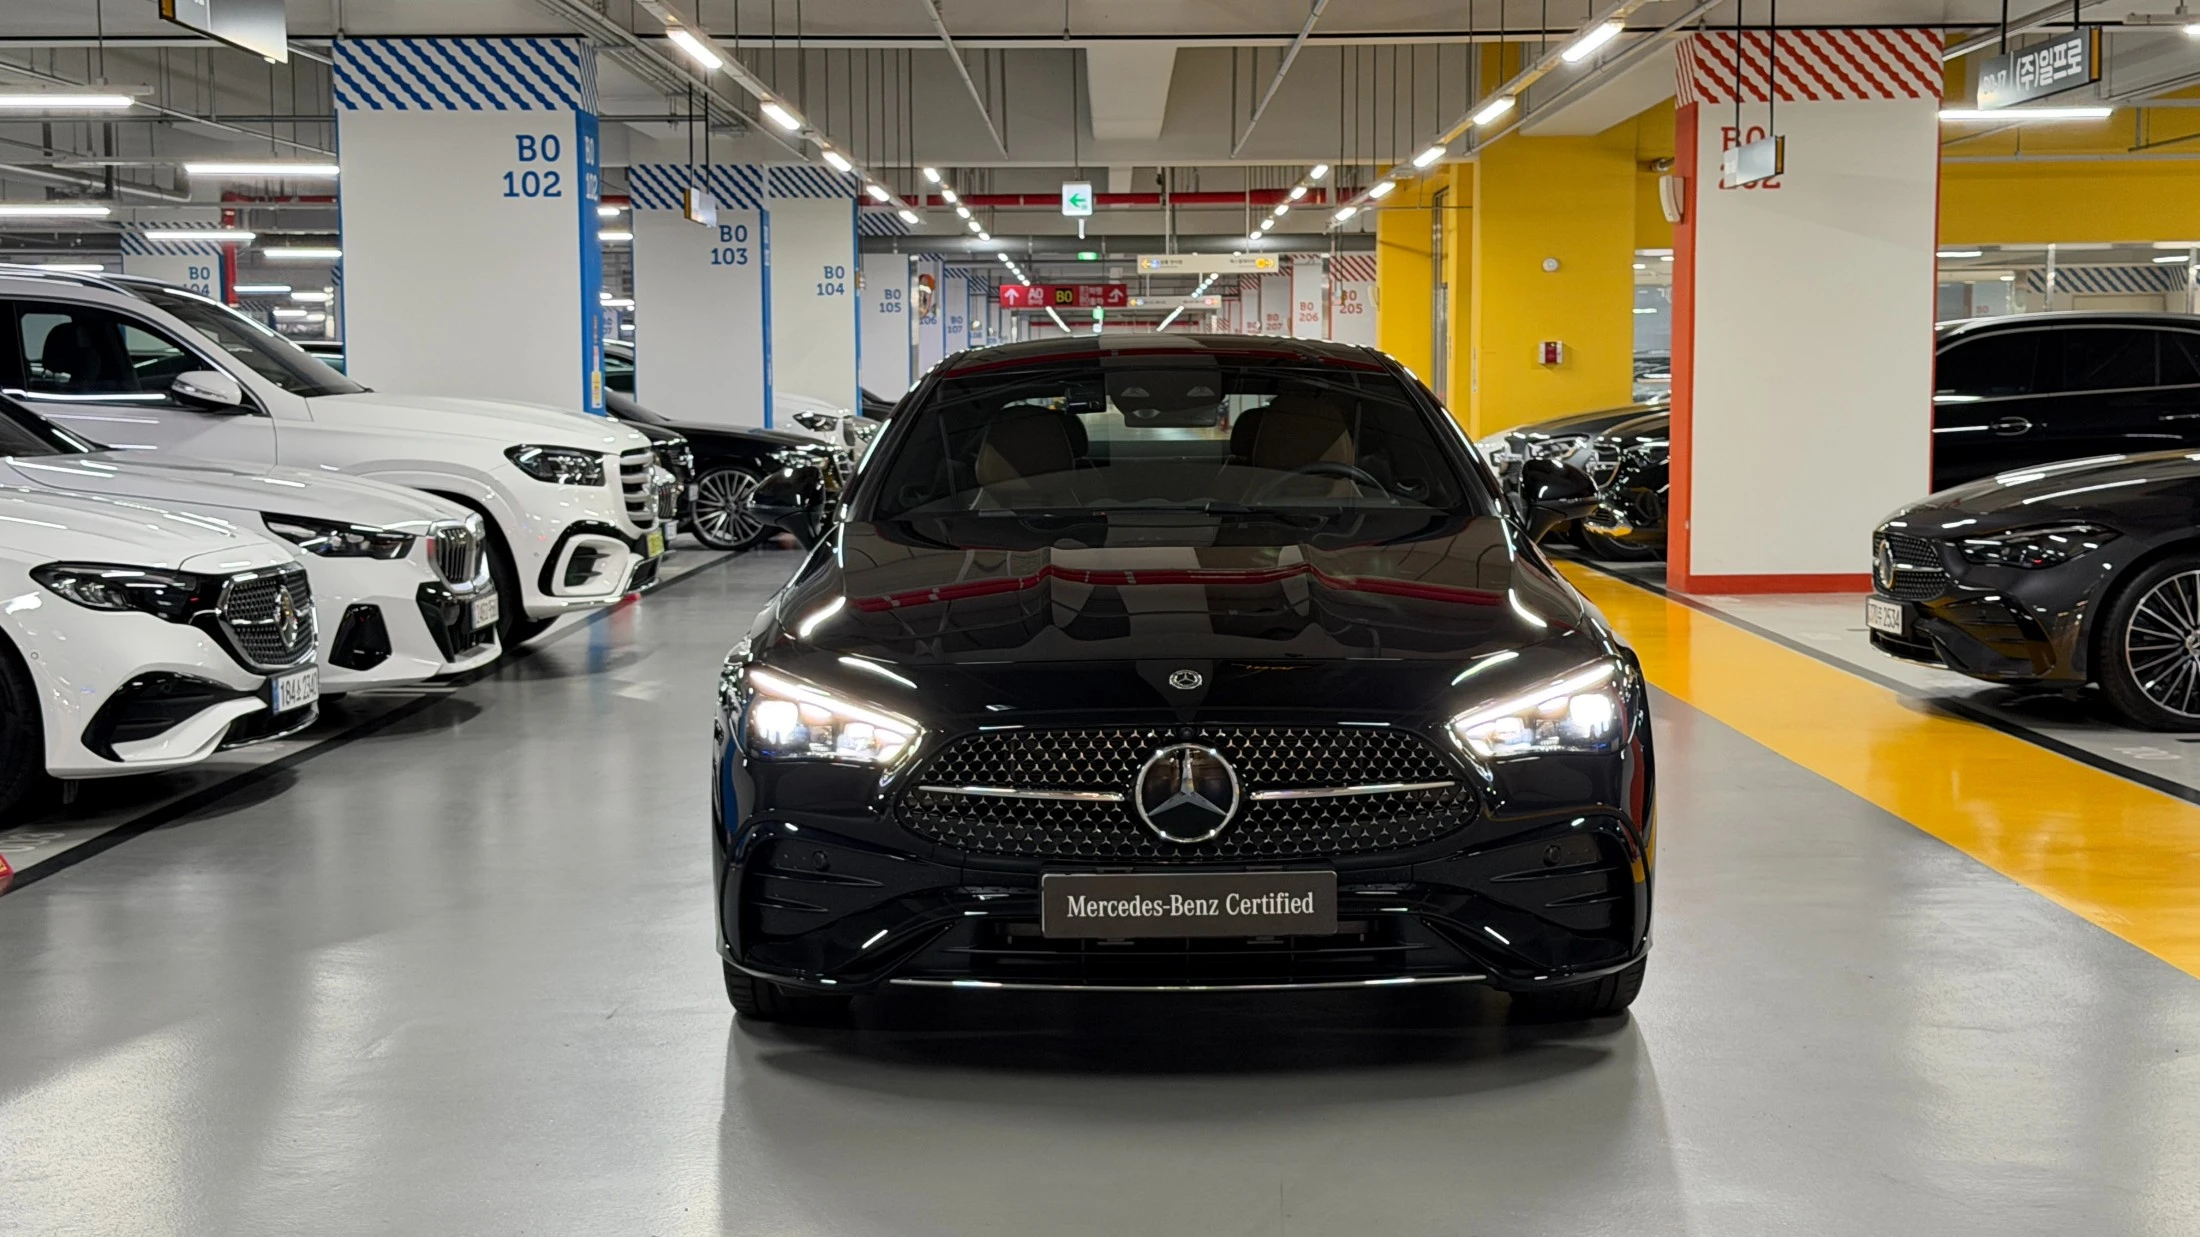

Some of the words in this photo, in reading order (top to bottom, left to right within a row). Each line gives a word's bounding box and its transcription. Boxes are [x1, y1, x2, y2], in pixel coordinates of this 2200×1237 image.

[2015, 38, 2082, 92] (주)일프로
[515, 134, 560, 162] B0
[503, 170, 562, 198] 102
[719, 224, 748, 242] B0
[711, 248, 748, 265] 103
[188, 266, 211, 280] B0
[823, 265, 845, 279] B0
[183, 283, 211, 297] 04
[817, 283, 845, 296] 104
[884, 289, 901, 300] B0
[1056, 291, 1073, 302] B0
[879, 302, 902, 313] 105
[1300, 302, 1314, 311] B0
[1340, 303, 1363, 314] 205
[1299, 313, 1319, 322] 206
[1067, 894, 1219, 917] Mercedes-Benz
[1226, 892, 1315, 914] Certified
